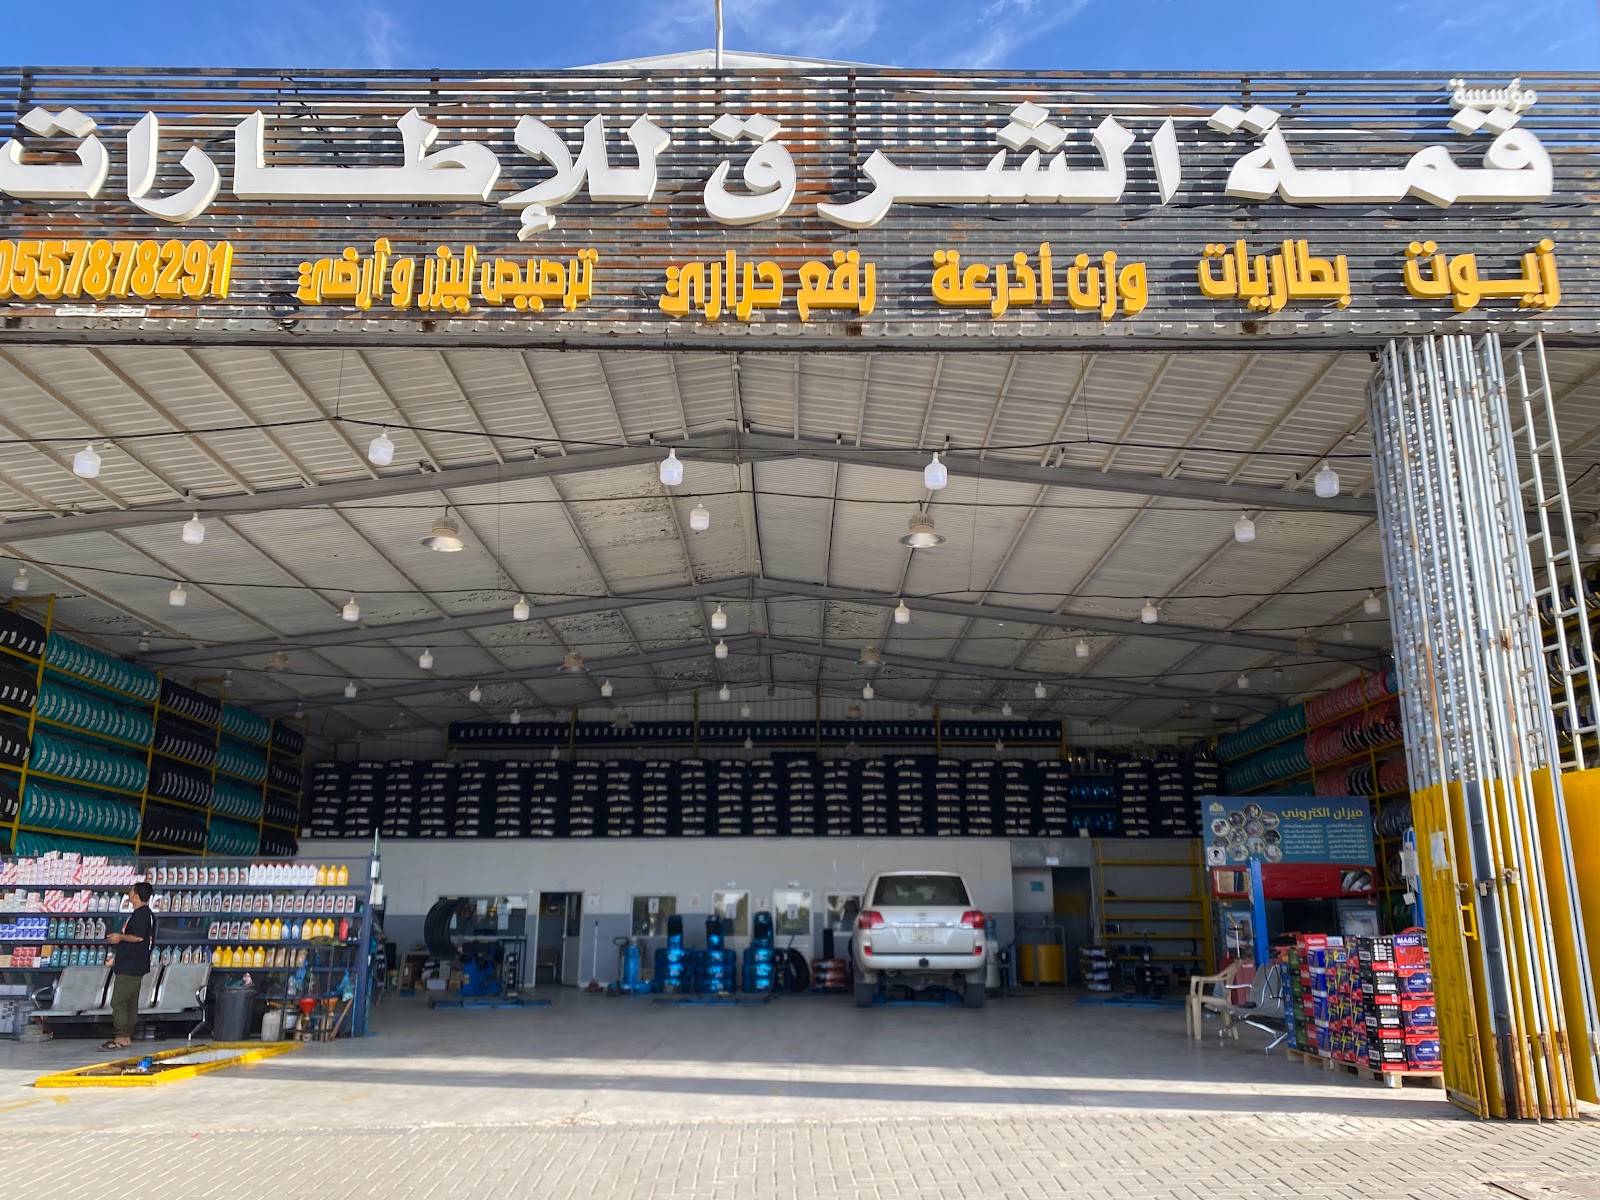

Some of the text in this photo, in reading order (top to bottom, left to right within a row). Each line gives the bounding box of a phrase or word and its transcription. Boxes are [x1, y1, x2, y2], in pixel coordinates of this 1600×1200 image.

[1446, 78, 1538, 113] مؤسسة
[703, 101, 1182, 229] الشرق
[1206, 104, 1555, 209] قمة
[0, 238, 235, 300] 0557878291
[417, 244, 478, 314] ليزر
[480, 248, 599, 314] ترصيص
[659, 249, 876, 322] رقع حراري
[931, 242, 1149, 321] وزن أذرعة
[1198, 239, 1352, 313] بطاريات
[1403, 238, 1561, 313] زيوت
[1333, 807, 1364, 820] ميزان
